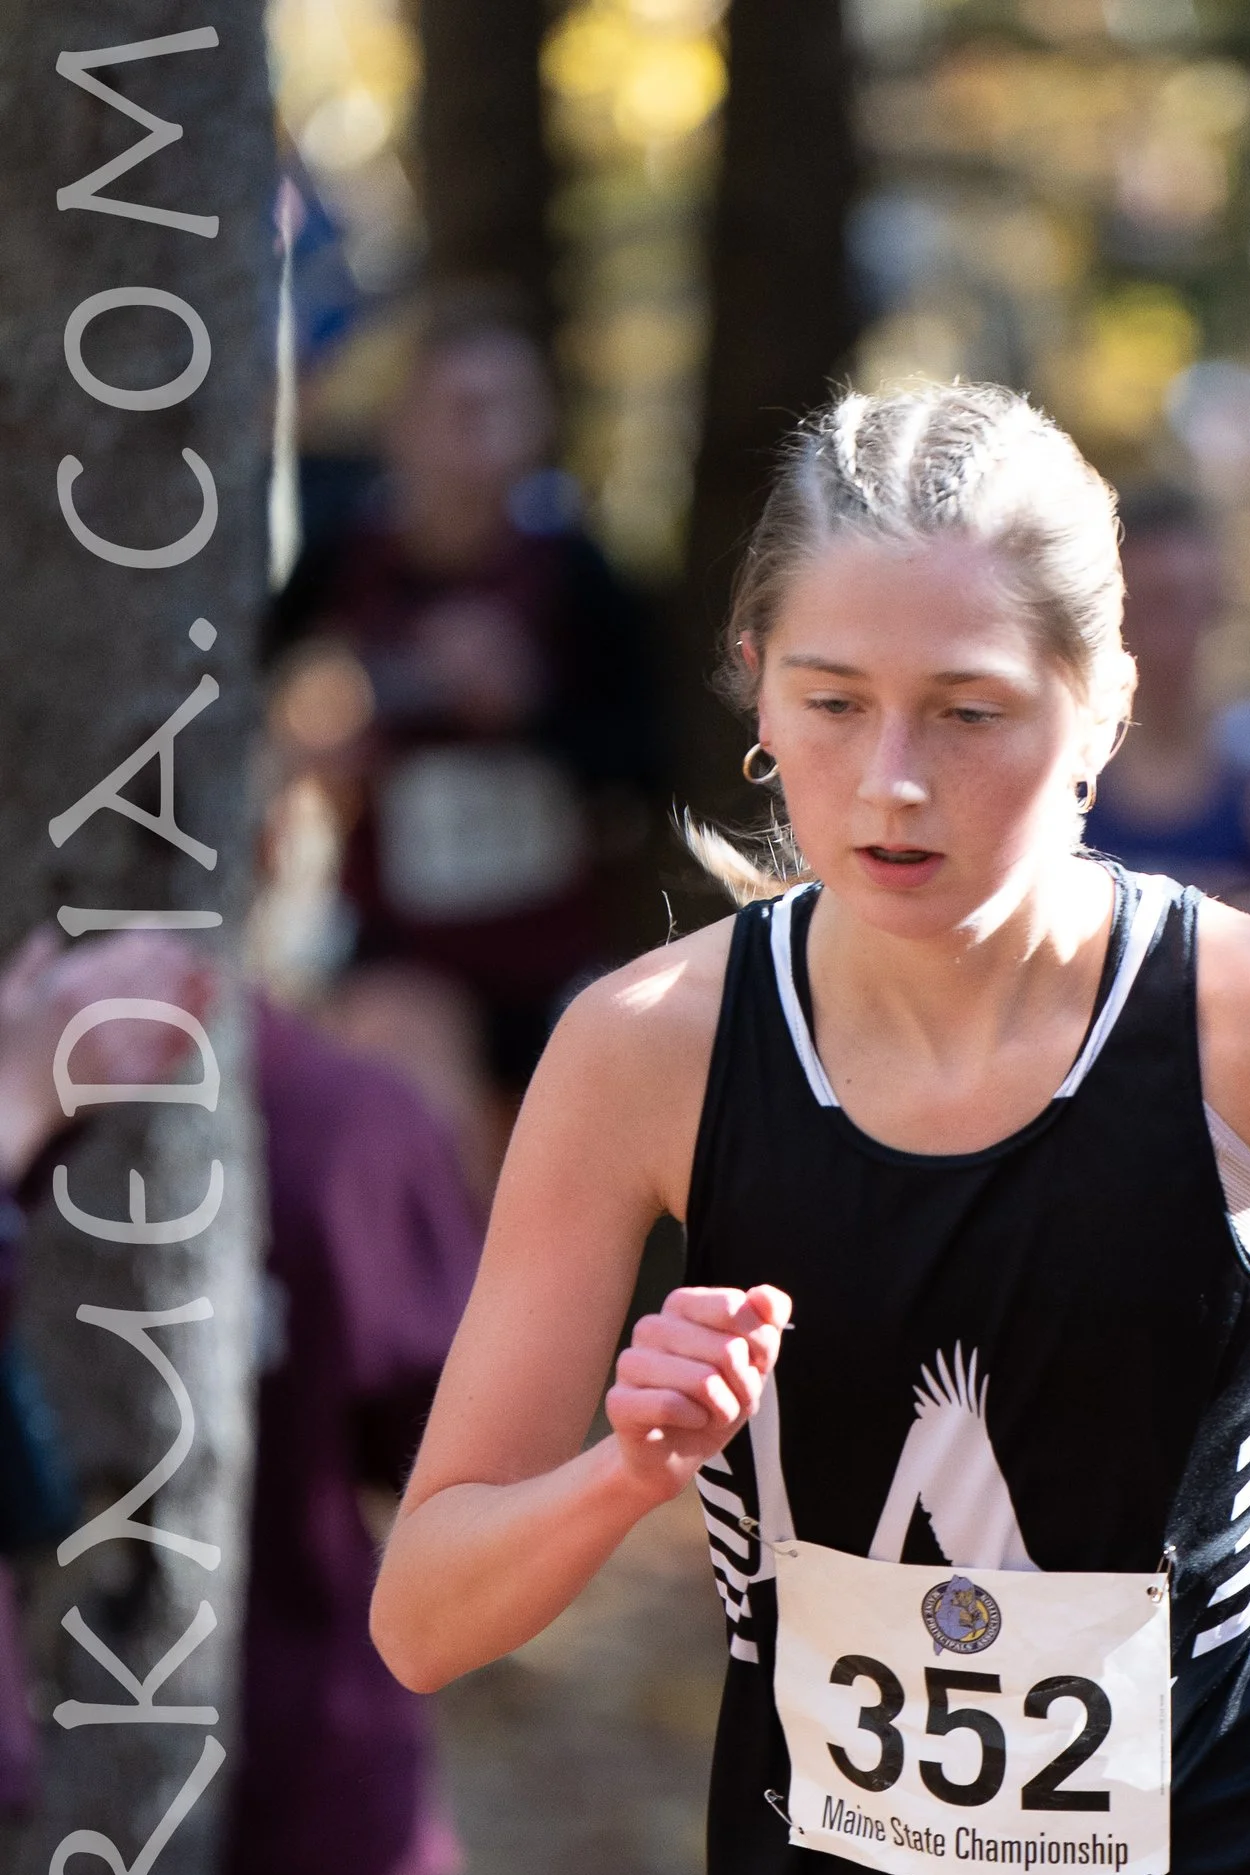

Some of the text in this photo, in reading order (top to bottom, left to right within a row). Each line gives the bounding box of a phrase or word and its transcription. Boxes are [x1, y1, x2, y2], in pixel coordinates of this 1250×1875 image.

[826, 1654, 1113, 1813] 352
[822, 1795, 1129, 1872] Maine State Championship
